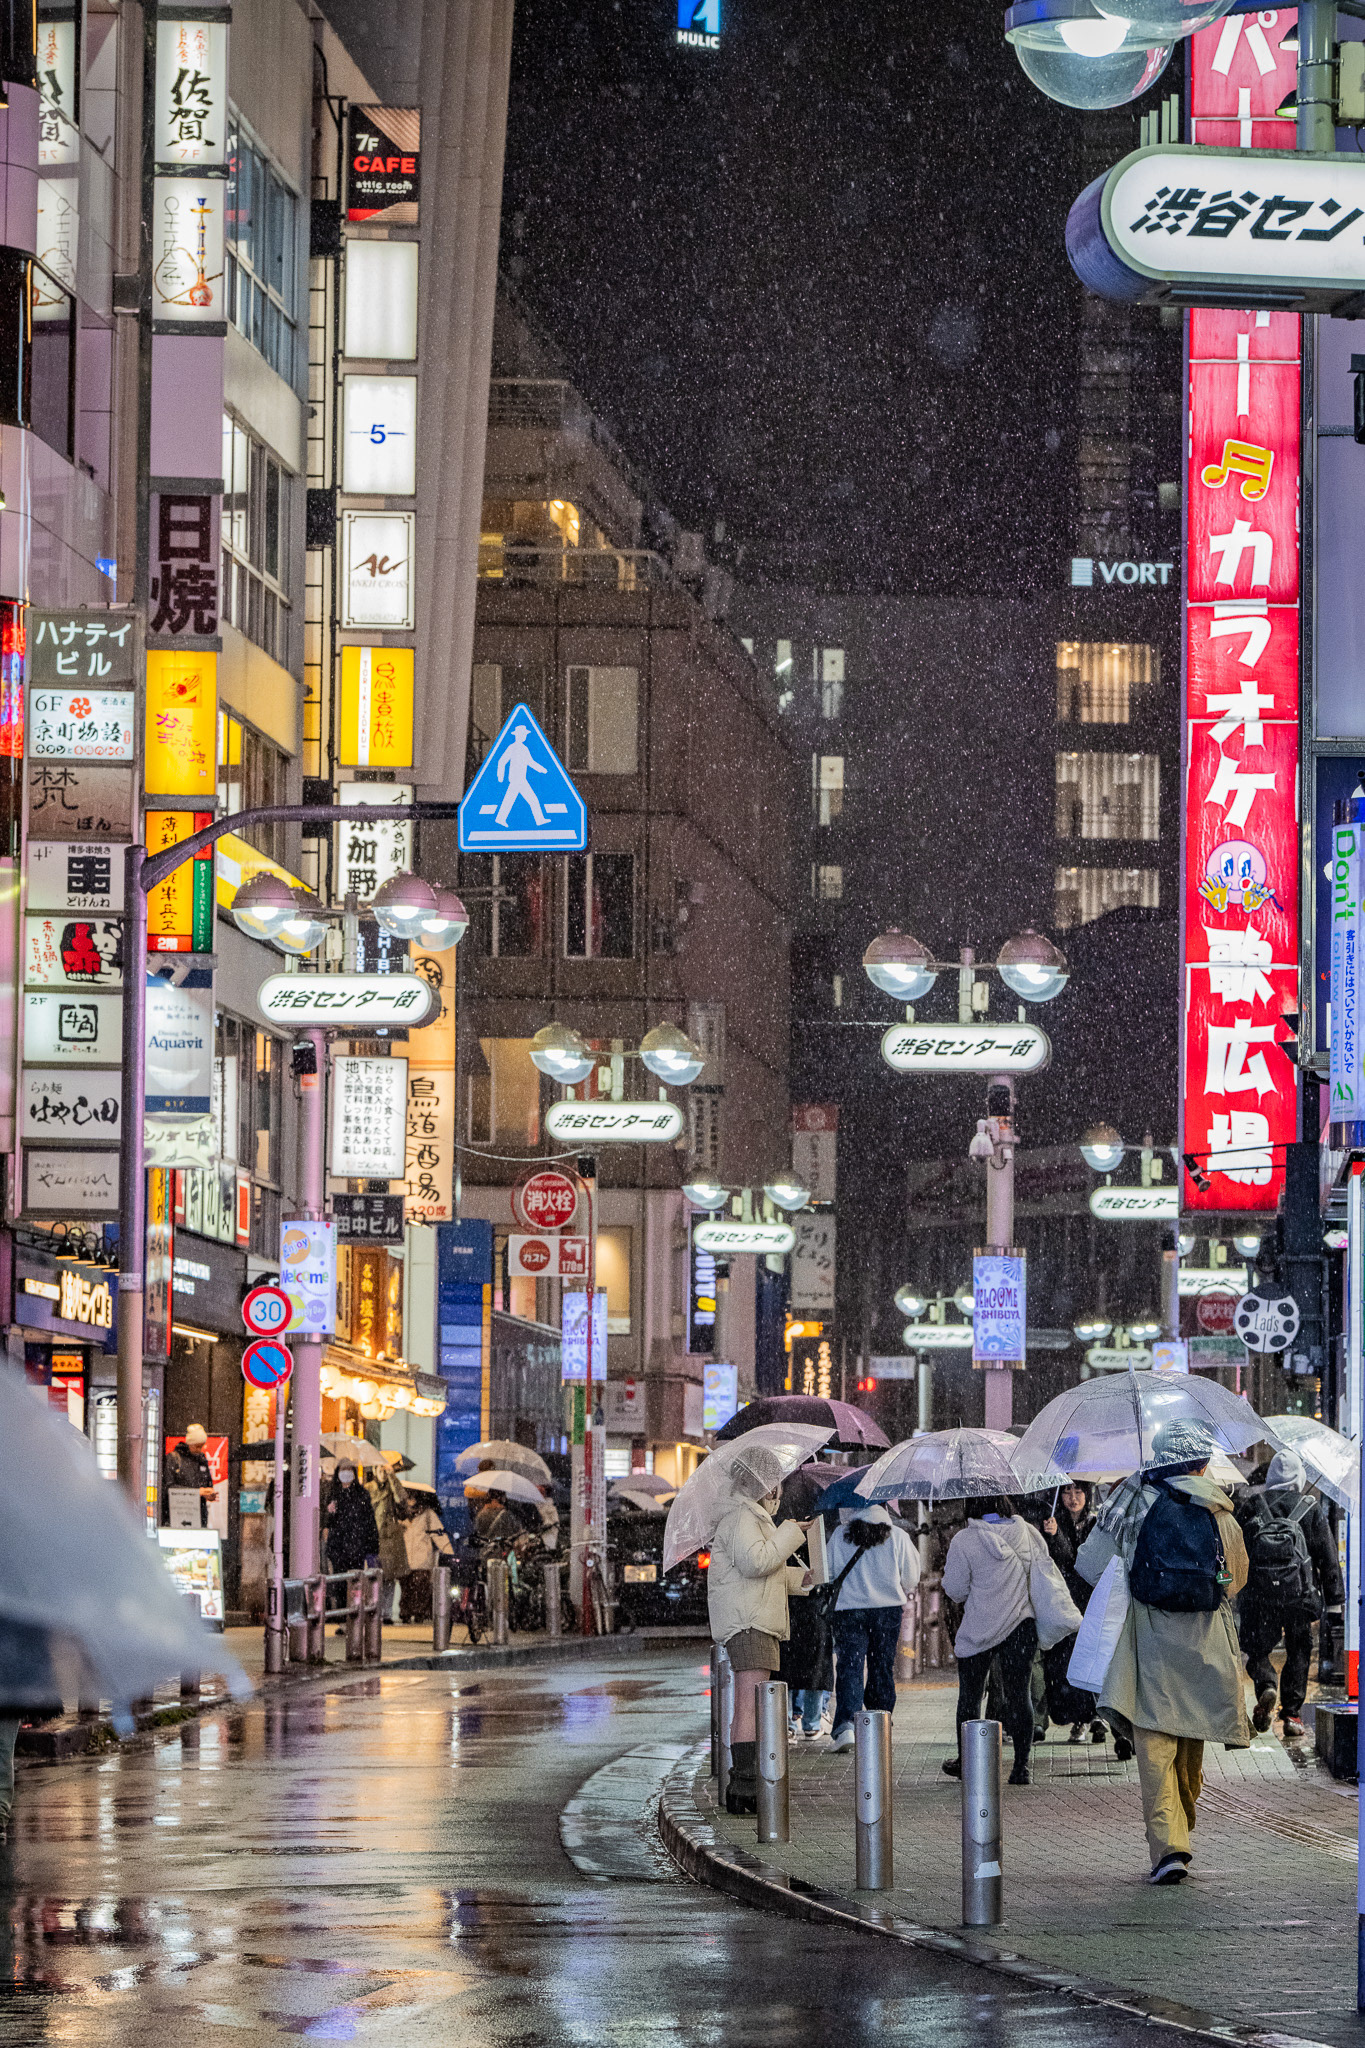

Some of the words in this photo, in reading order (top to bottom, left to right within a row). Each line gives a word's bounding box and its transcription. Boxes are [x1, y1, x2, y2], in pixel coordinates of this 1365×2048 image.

[678, 30, 720, 49] HULIC
[166, 68, 215, 147] 佐賀
[356, 134, 379, 152] 7F
[179, 149, 200, 159] 7F
[353, 155, 416, 174] CAFE
[356, 180, 383, 189] attic
[385, 180, 412, 190] room
[1130, 186, 1365, 246] 渋谷セン
[369, 424, 386, 444] 5
[150, 494, 217, 634] 日焼
[1098, 561, 1174, 585] VORT
[57, 651, 112, 677] ビル
[1204, 517, 1277, 832] カラオケ
[35, 695, 63, 712] 6F
[373, 662, 397, 748] 鳥貴族
[34, 720, 122, 743] 京町物語
[68, 845, 111, 854] 博多串焼き
[1335, 830, 1356, 923] Don't
[66, 896, 110, 908] どげんね
[268, 989, 421, 1009] 渋谷センター街
[1343, 929, 1356, 1074] 客引きにはついていかないで
[64, 1011, 94, 1033] 牛角
[148, 1036, 203, 1051] Aquavit
[892, 1038, 1036, 1057] 渋谷センター街
[1203, 922, 1278, 1186] 歌広場
[346, 1061, 393, 1074] 地下だけ
[554, 1114, 674, 1129] 渋谷センター街
[527, 1190, 573, 1211] 消火栓
[338, 1216, 399, 1234] 田中ビル
[282, 1237, 309, 1260] Enjoy
[281, 1269, 329, 1284] Welcome
[976, 1287, 1018, 1308] WELCOME
[255, 1301, 281, 1322] 30
[981, 1310, 1020, 1320] SHIBUYA
[1254, 1314, 1279, 1332] Lad's
